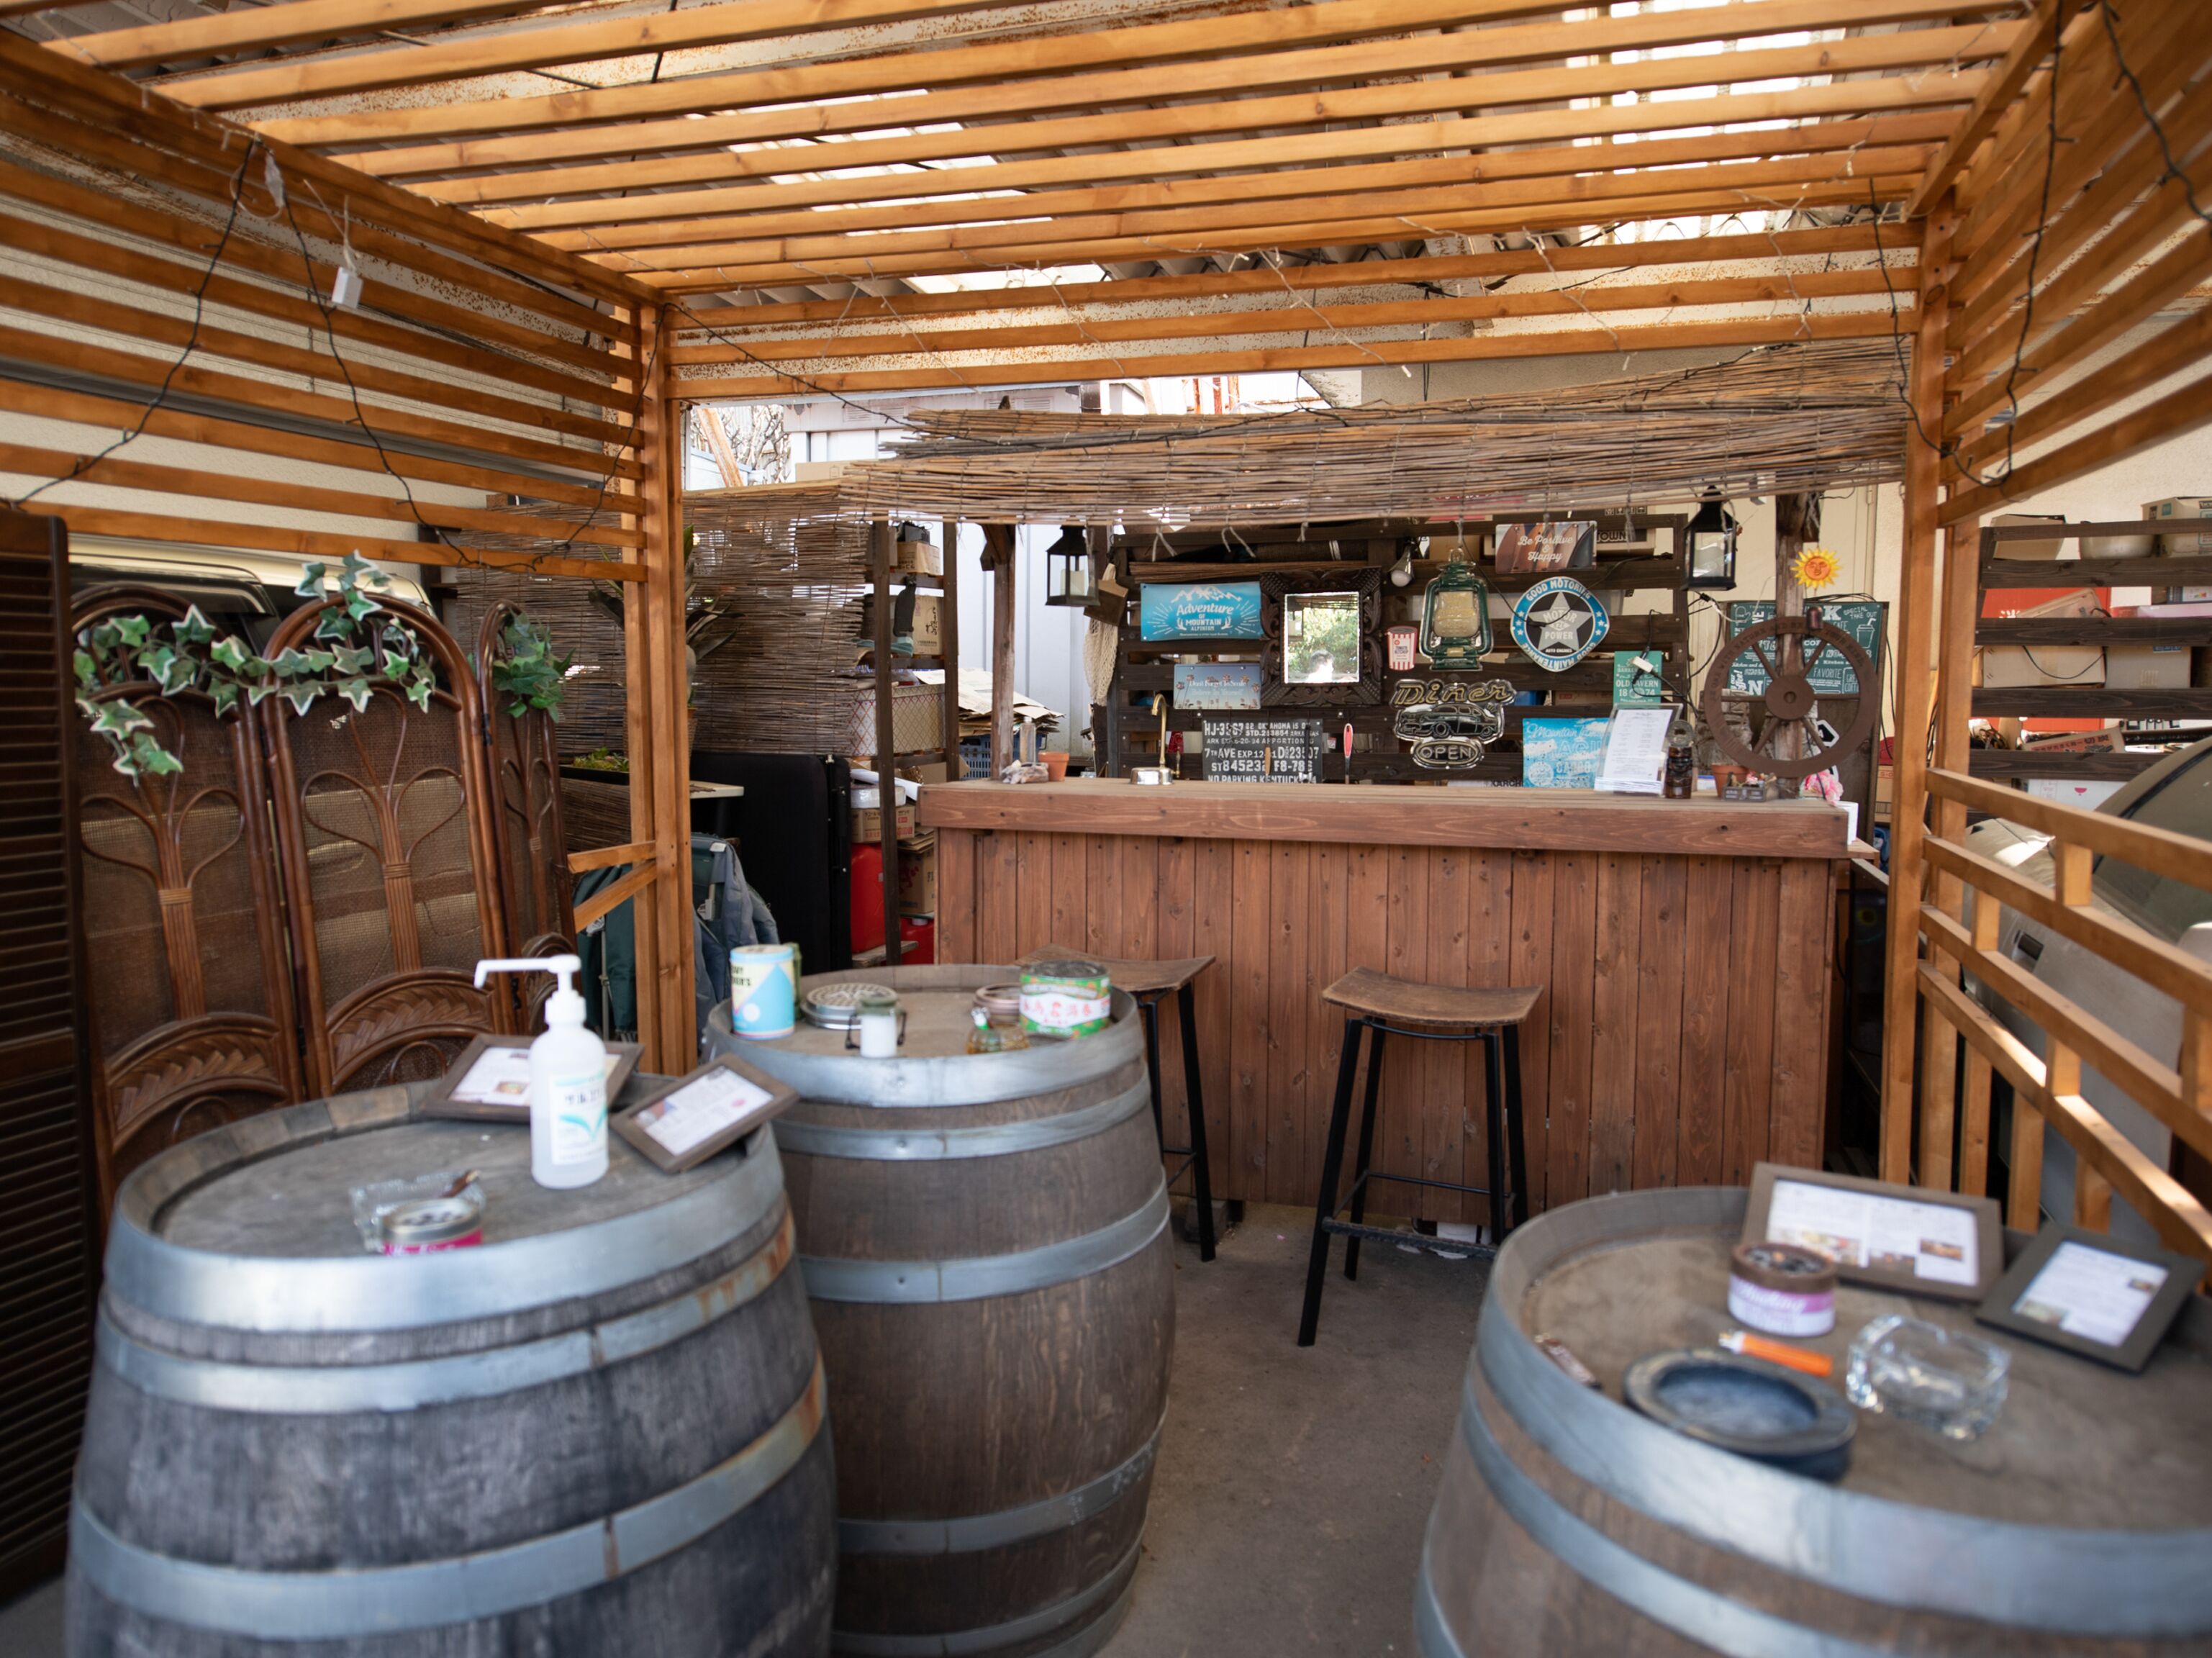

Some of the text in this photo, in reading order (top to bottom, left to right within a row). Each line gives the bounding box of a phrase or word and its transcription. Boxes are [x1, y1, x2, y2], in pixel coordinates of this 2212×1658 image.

[1518, 535, 1574, 545] Be Positive
[1527, 552, 1563, 562] Happy
[1526, 579, 1591, 602] GOOD MOTORING
[1177, 603, 1235, 616] Adventure
[1843, 606, 1868, 616] SPECIAL
[1542, 610, 1578, 624] MOTOR
[1544, 631, 1574, 640] POWER
[1522, 639, 1596, 671] GOOD MAINTENANCE
[1813, 668, 1842, 679] FAVORITE
[1394, 684, 1510, 705] Diner
[1526, 723, 1578, 738] Mountain
[1218, 748, 1236, 758] AVE
[1420, 746, 1472, 760] OPEN
